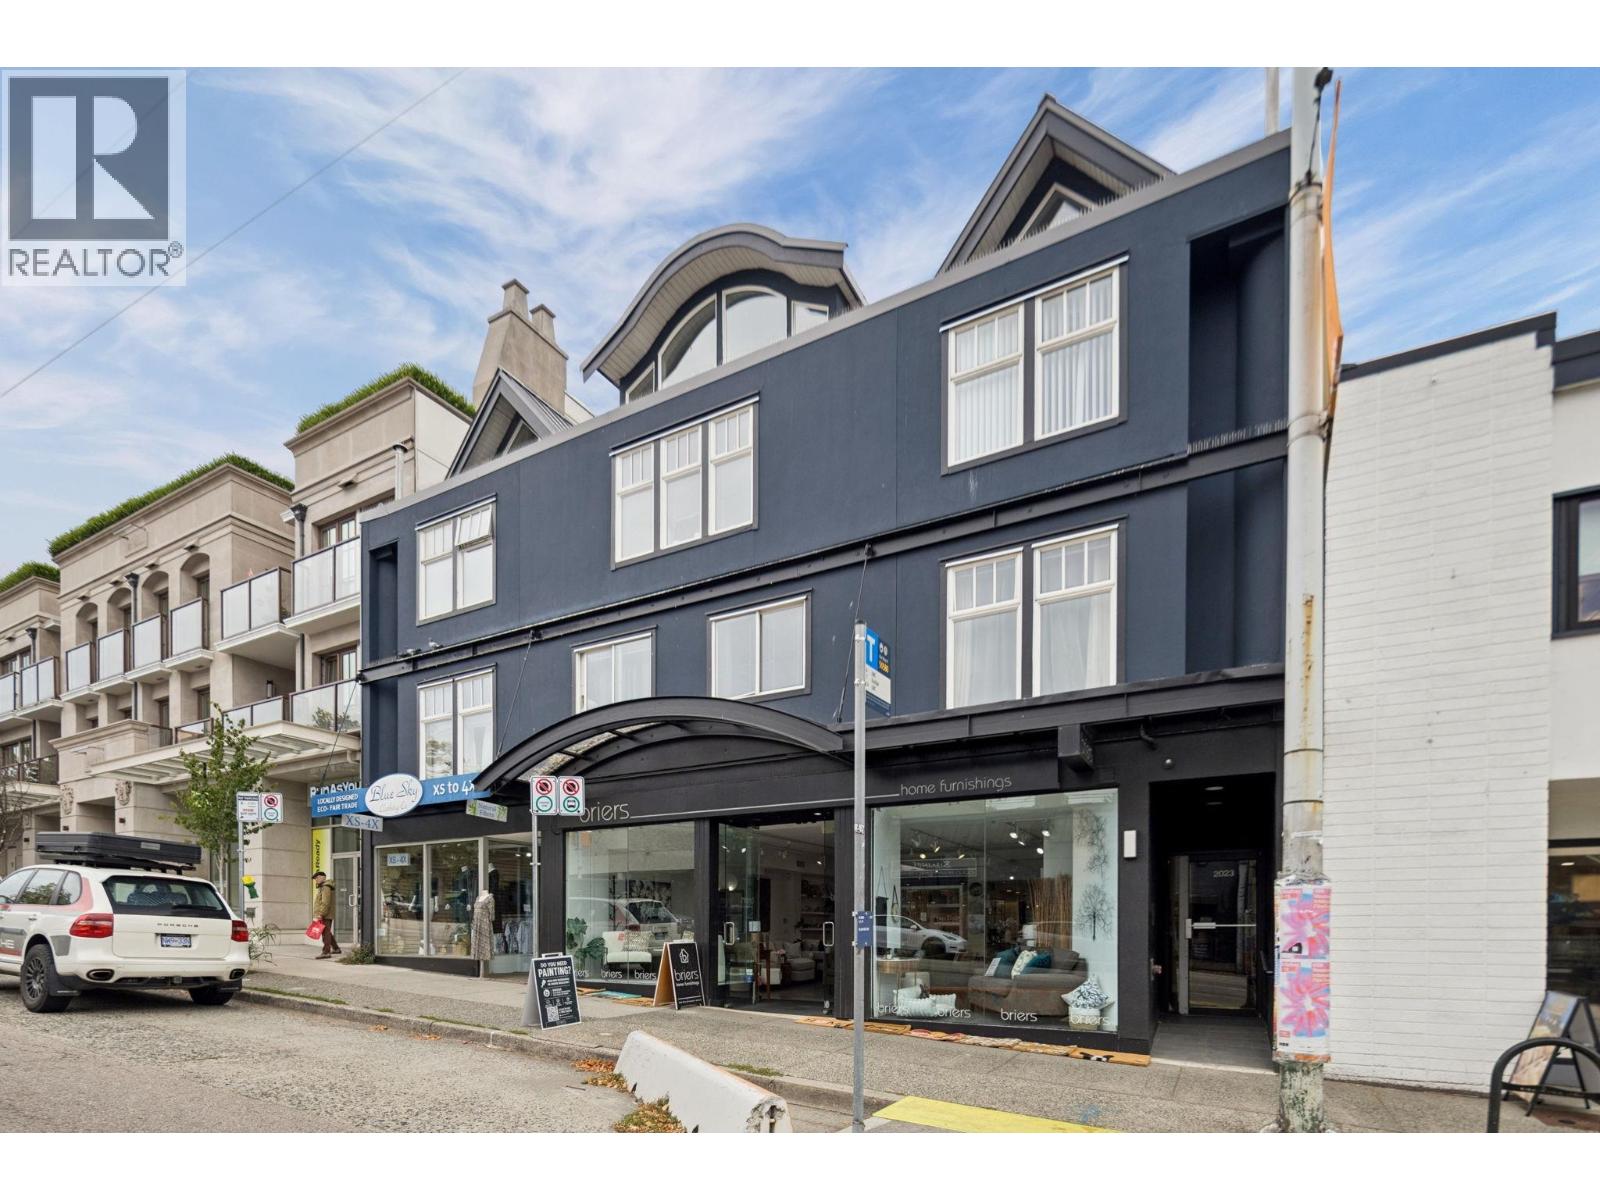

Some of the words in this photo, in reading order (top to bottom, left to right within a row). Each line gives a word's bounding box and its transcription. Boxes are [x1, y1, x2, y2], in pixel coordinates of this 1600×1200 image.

[368, 784, 394, 802] Blue
[395, 780, 419, 803] Sky
[433, 784, 445, 796] XS
[448, 781, 459, 794] to
[901, 784, 936, 796] home
[940, 777, 1012, 792] furnishings
[317, 797, 336, 805] LOCALLY
[336, 793, 359, 802] DESIGNED
[330, 803, 341, 811] FAIR
[341, 802, 358, 810] TRADE
[346, 815, 380, 829] XS-4X
[1213, 869, 1235, 878] 2023
[538, 966, 571, 978] PAINTING?
[601, 969, 622, 979] briers
[634, 969, 657, 980] briers
[673, 969, 699, 981] briers
[1000, 1008, 1038, 1022] briers
